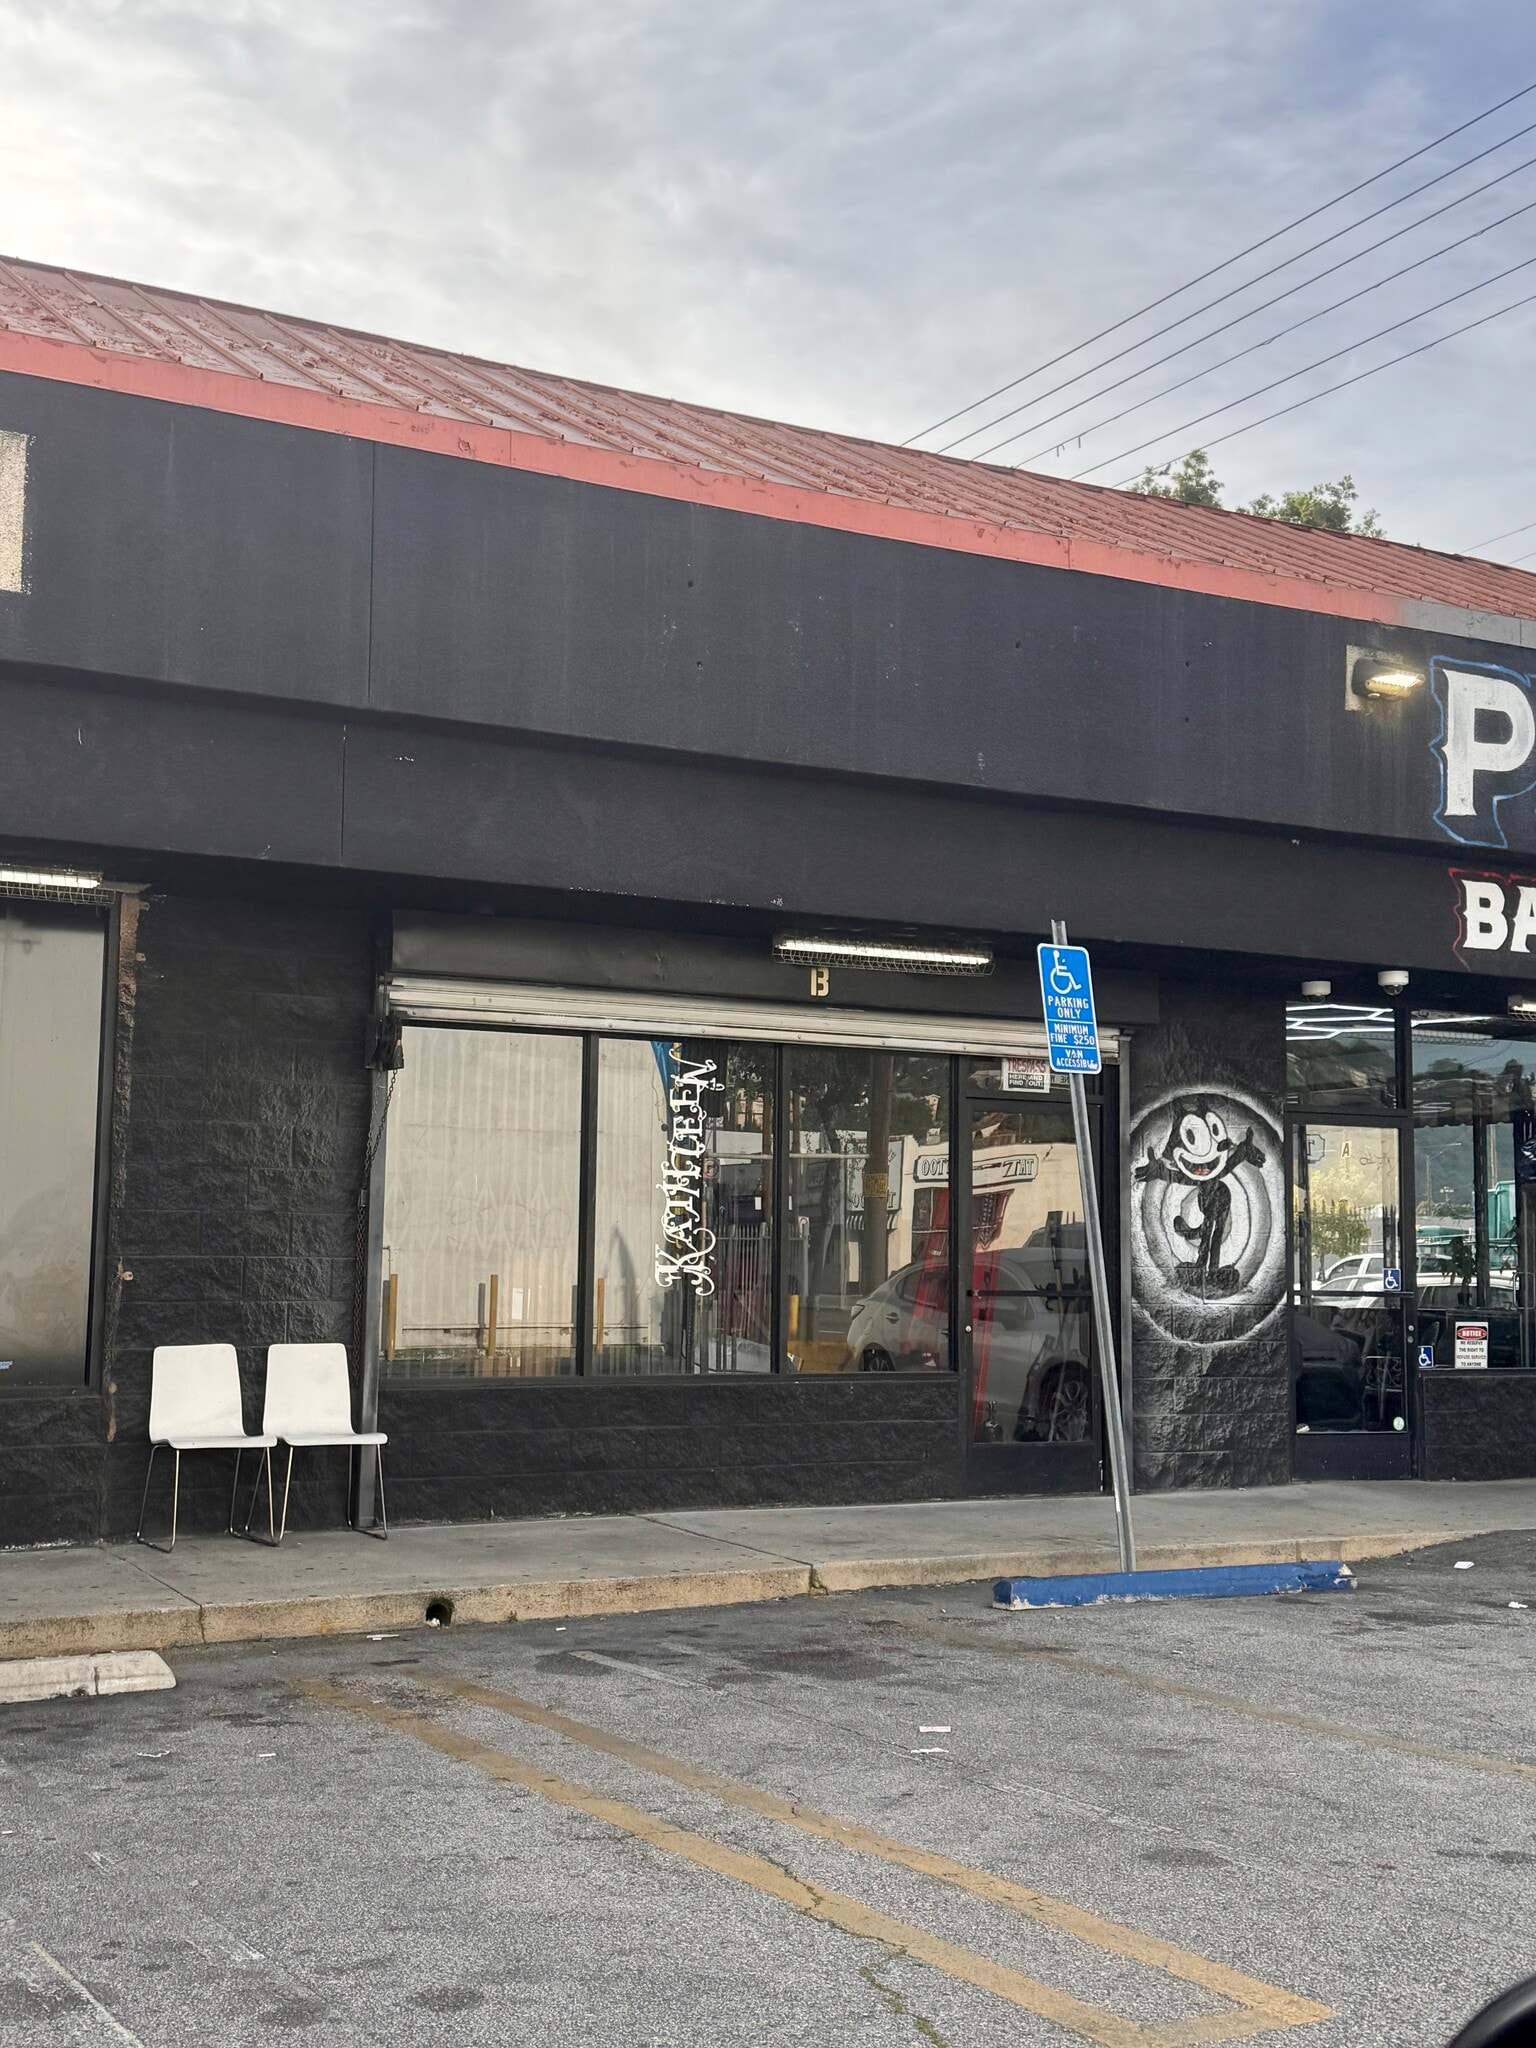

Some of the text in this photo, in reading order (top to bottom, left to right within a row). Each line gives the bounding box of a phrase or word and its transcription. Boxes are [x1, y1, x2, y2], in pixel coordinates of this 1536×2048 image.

[810, 967, 830, 997] B
[1047, 995, 1089, 1009] PARKING
[1057, 1007, 1081, 1019] ONLY
[1054, 1023, 1089, 1035] MINIMUM
[1050, 1032, 1095, 1046] FINE $250
[1065, 1048, 1083, 1059] VAN
[1007, 1059, 1046, 1073] TRESPASS
[1342, 1143, 1350, 1158] A
[655, 1048, 725, 1296] KATHLEEN
